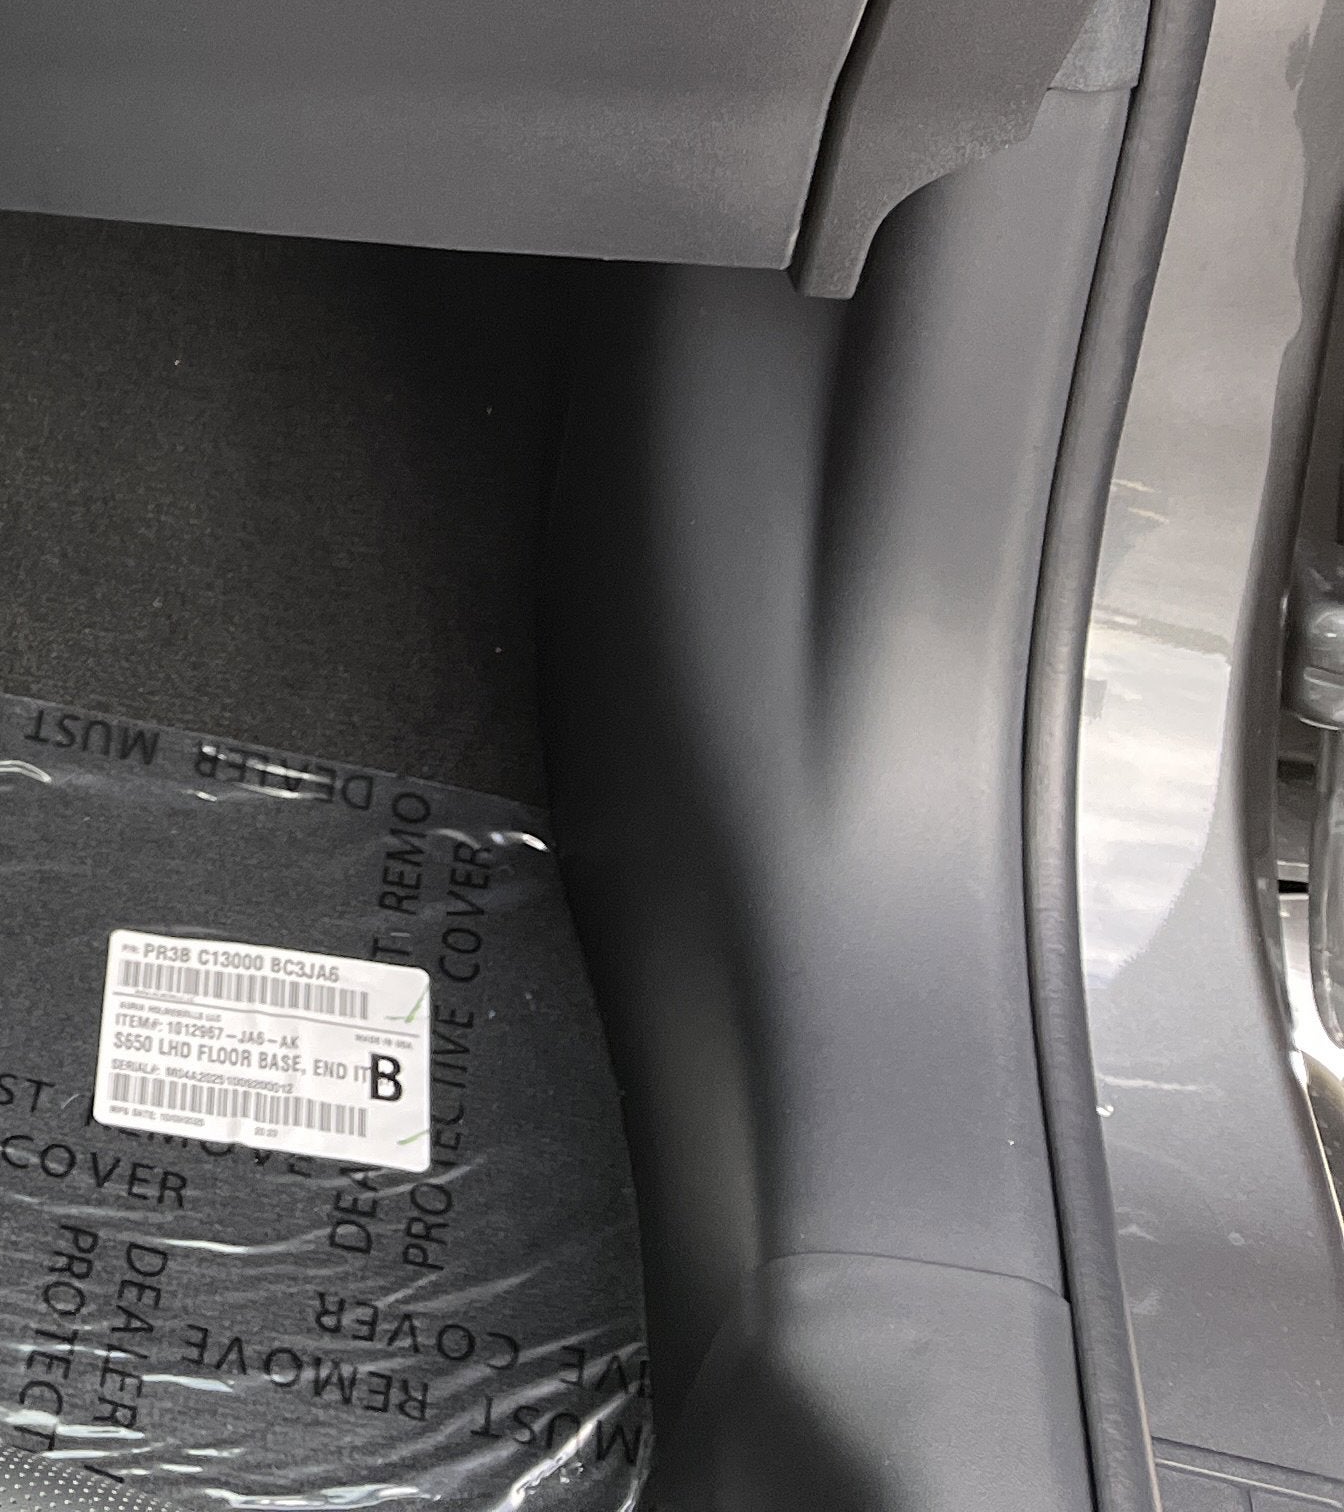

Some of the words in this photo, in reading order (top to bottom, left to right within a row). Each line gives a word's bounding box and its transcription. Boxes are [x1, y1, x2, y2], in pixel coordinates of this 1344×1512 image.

[24, 708, 160, 766] MUST
[438, 839, 494, 985] COVER
[197, 946, 264, 973] C13000
[111, 1030, 153, 1054] S650
[157, 1037, 192, 1060] LHD
[196, 1042, 252, 1069] FLOOR
[257, 1048, 306, 1076] BASE,
[312, 1058, 347, 1080] END
[370, 1052, 403, 1102] B
[1, 1133, 188, 1209] COVER
[92, 1242, 169, 1431] DEALER
[315, 1290, 521, 1370] COVER
[179, 1321, 430, 1422] REMOVE
[470, 1396, 646, 1464] MUST
